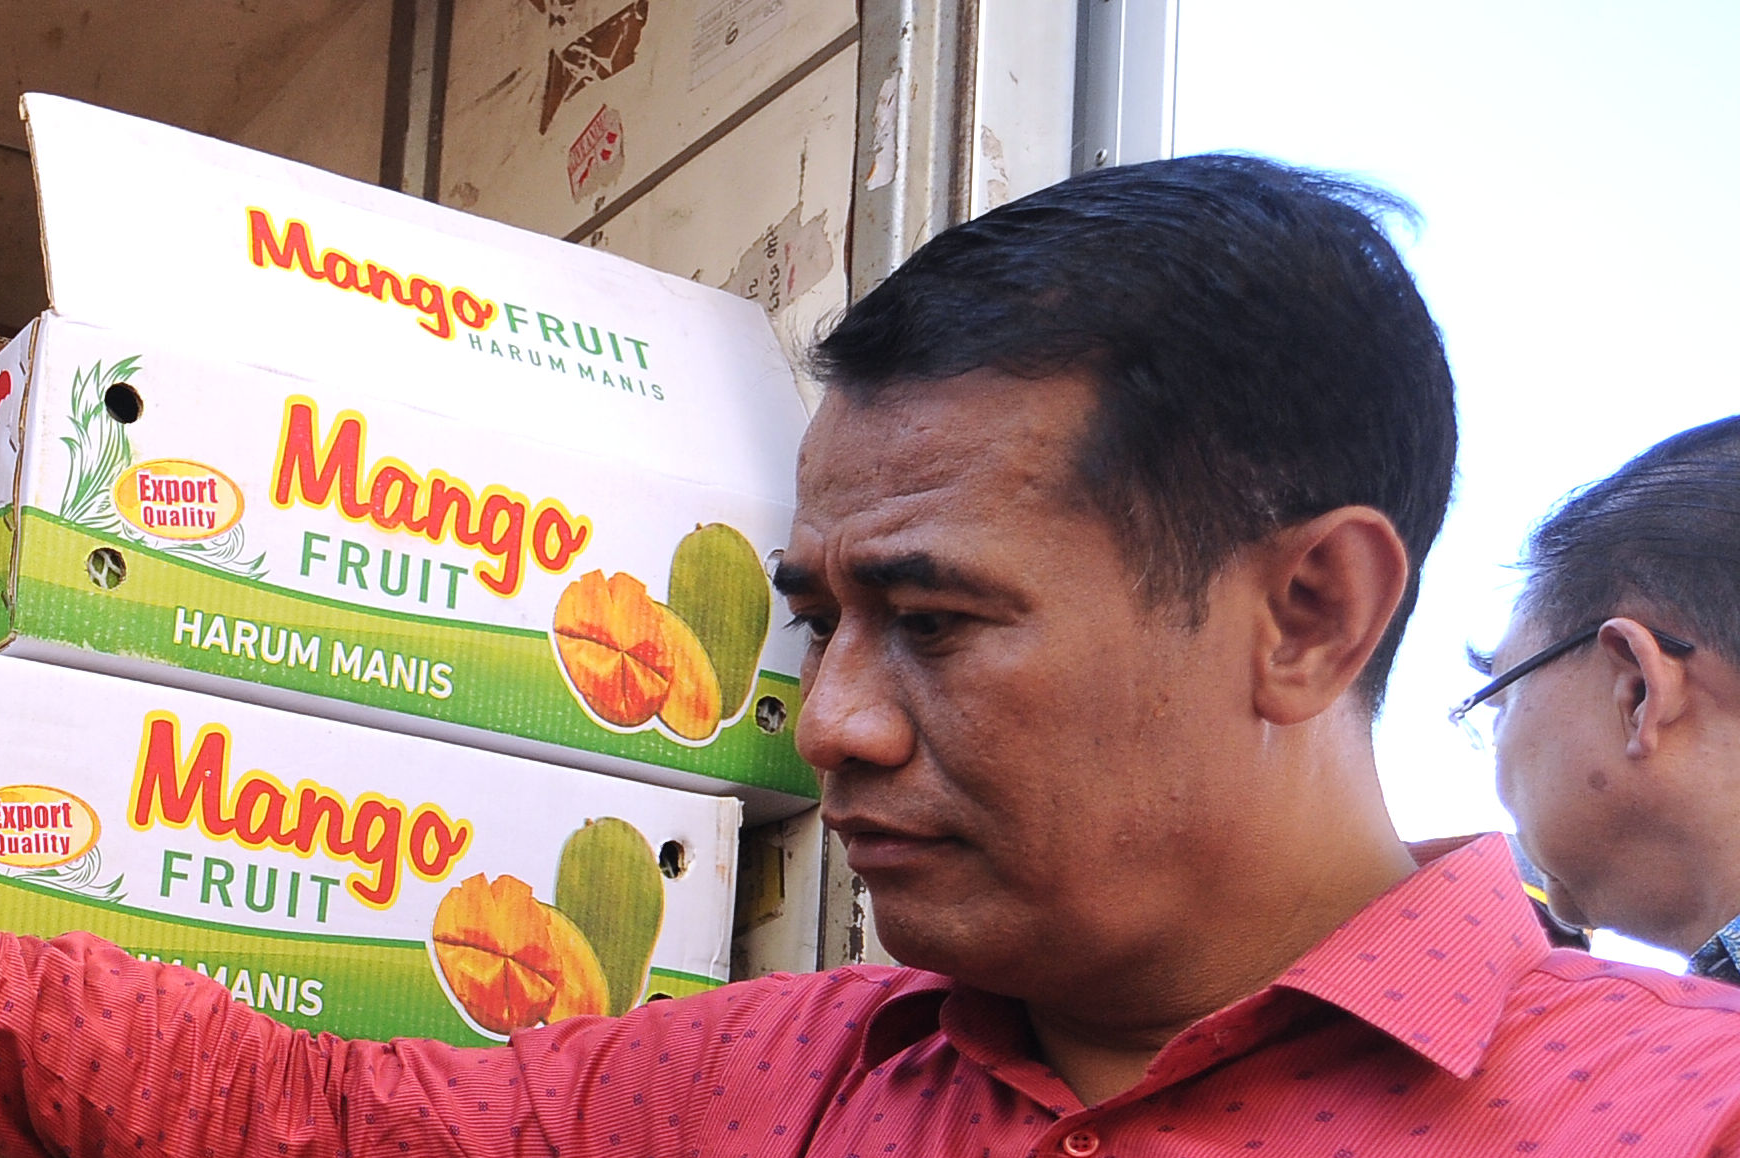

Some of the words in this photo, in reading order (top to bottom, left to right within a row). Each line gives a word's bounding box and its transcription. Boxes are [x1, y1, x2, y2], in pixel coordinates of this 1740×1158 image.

[247, 207, 494, 341] Mango
[504, 302, 651, 371] FRUIT
[468, 333, 567, 375] HARUM
[577, 363, 666, 401] MANIS
[136, 470, 219, 508] Export
[141, 503, 217, 531] Quality
[271, 397, 591, 597] Mango
[298, 530, 470, 611] FRUIT
[173, 607, 321, 675] HARUM
[330, 642, 455, 701] MANIS
[128, 711, 471, 909] Mango
[159, 851, 343, 925] FRUIT
